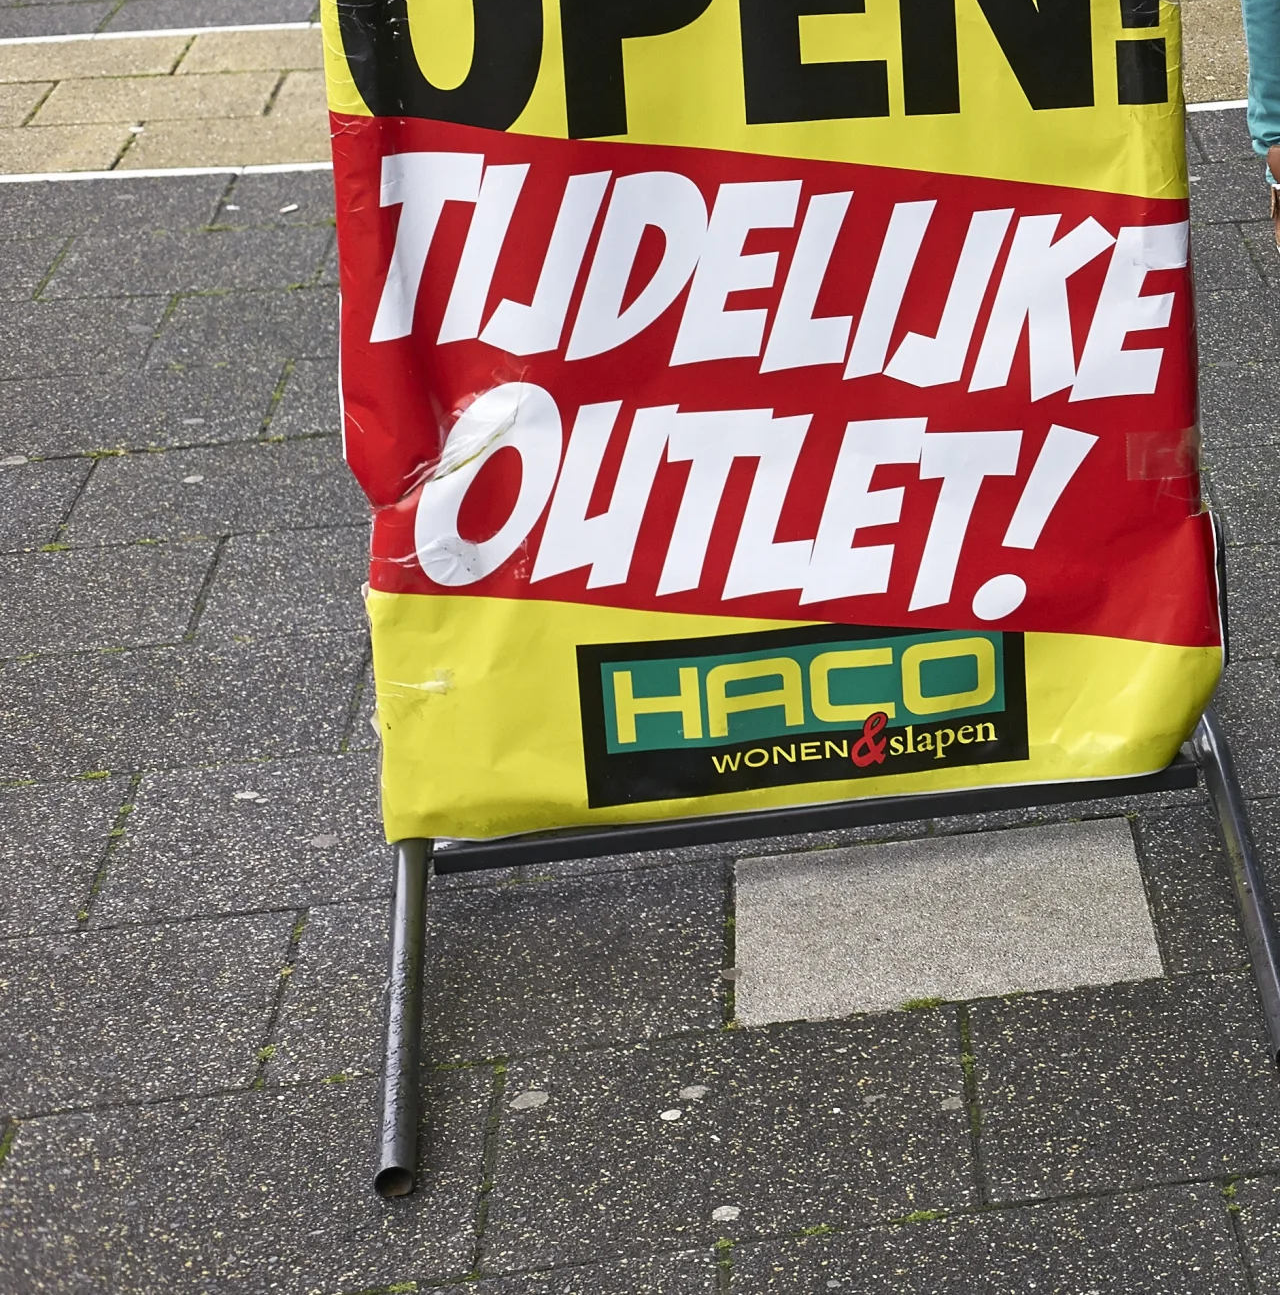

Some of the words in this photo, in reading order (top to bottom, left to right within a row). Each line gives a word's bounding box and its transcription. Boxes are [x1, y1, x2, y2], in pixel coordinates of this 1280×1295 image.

[368, 151, 1192, 403] TIJDELIJKE
[413, 381, 1100, 622] OUTLET!
[612, 637, 998, 744] HACO
[711, 740, 851, 774] WONEN
[851, 711, 888, 769] &
[889, 714, 997, 767] slapen
